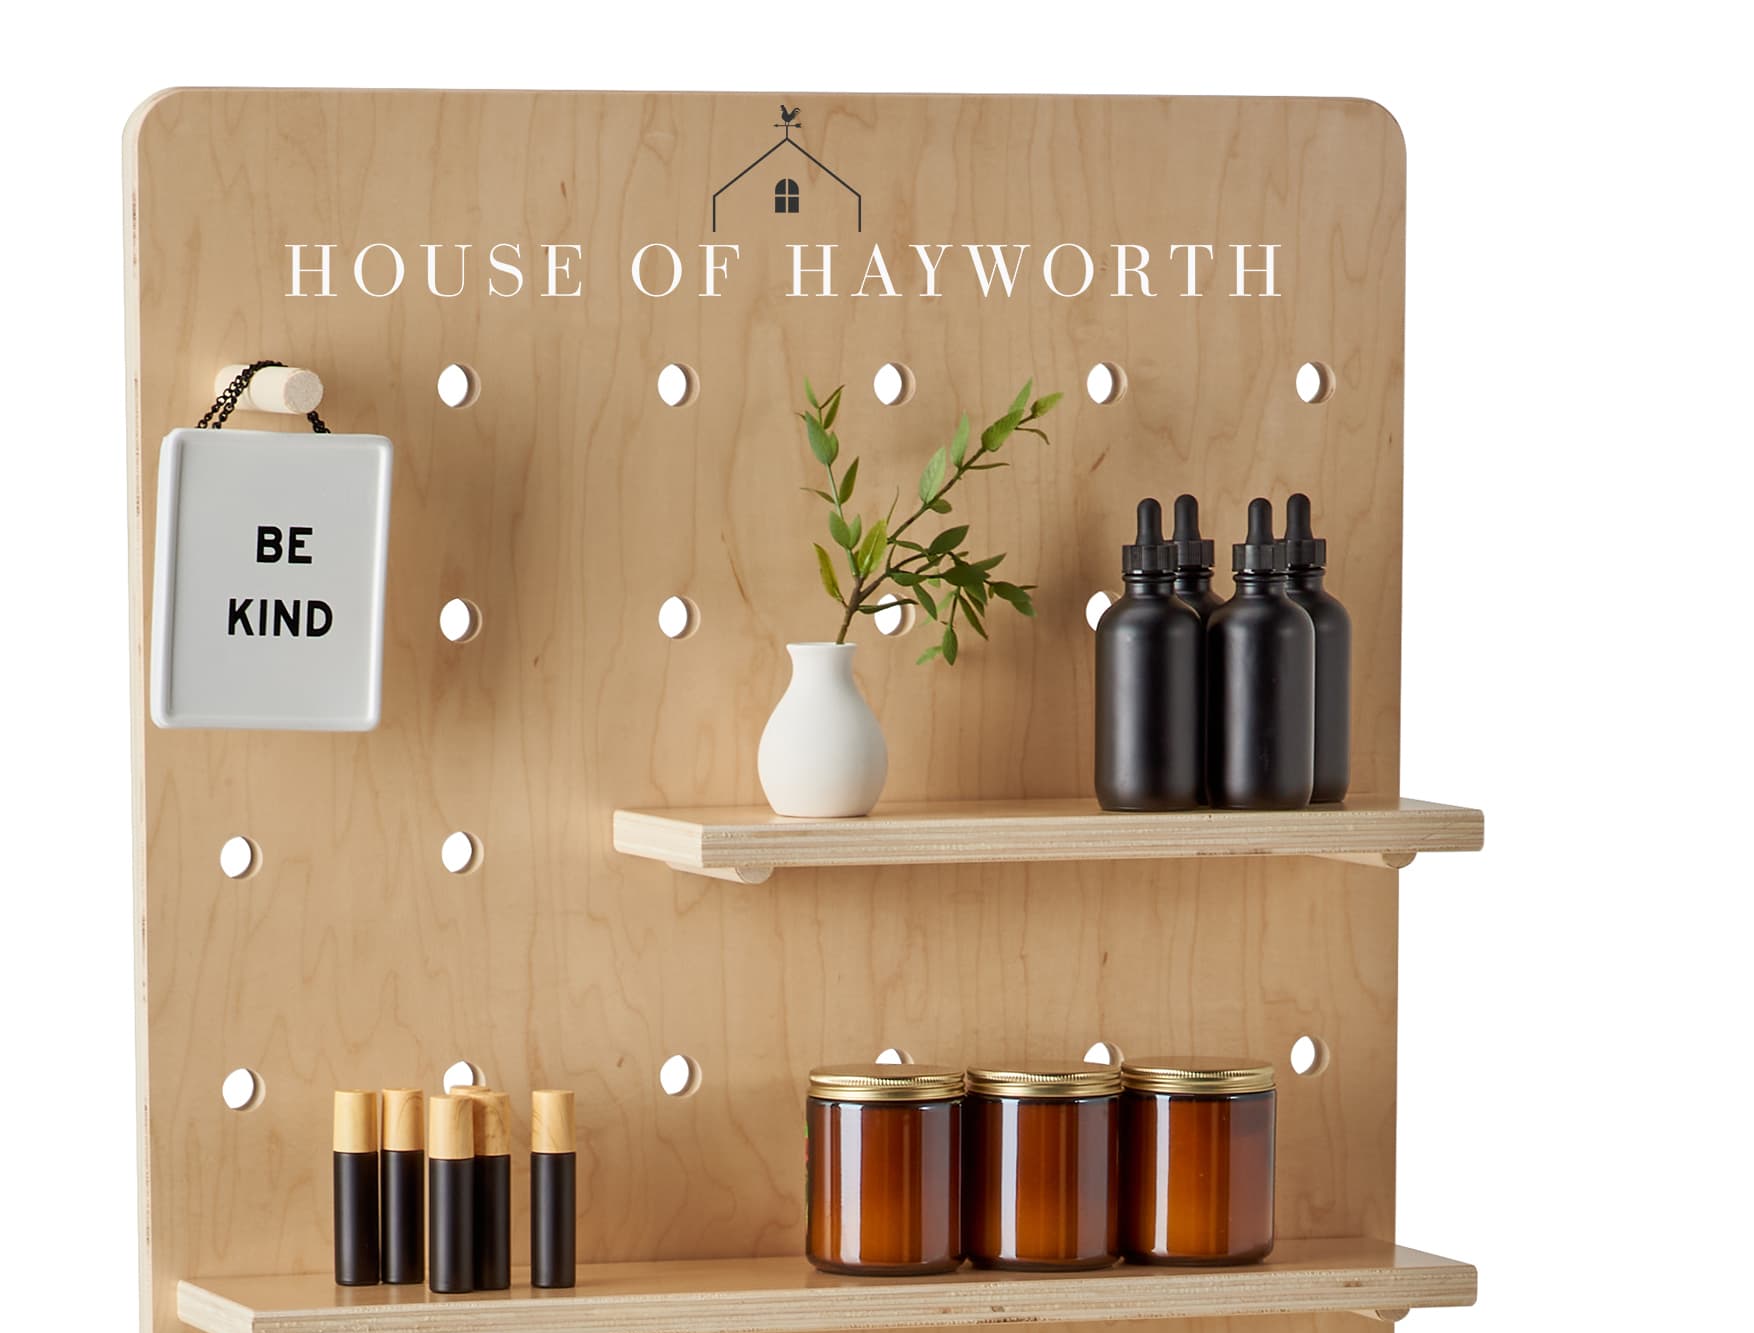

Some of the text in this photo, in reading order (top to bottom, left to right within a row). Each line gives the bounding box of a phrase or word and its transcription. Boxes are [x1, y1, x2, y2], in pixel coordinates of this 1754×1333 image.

[285, 243, 1281, 297] HOUSE OF HAYWORTH
[256, 526, 313, 564] BE
[228, 598, 333, 637] KIND
